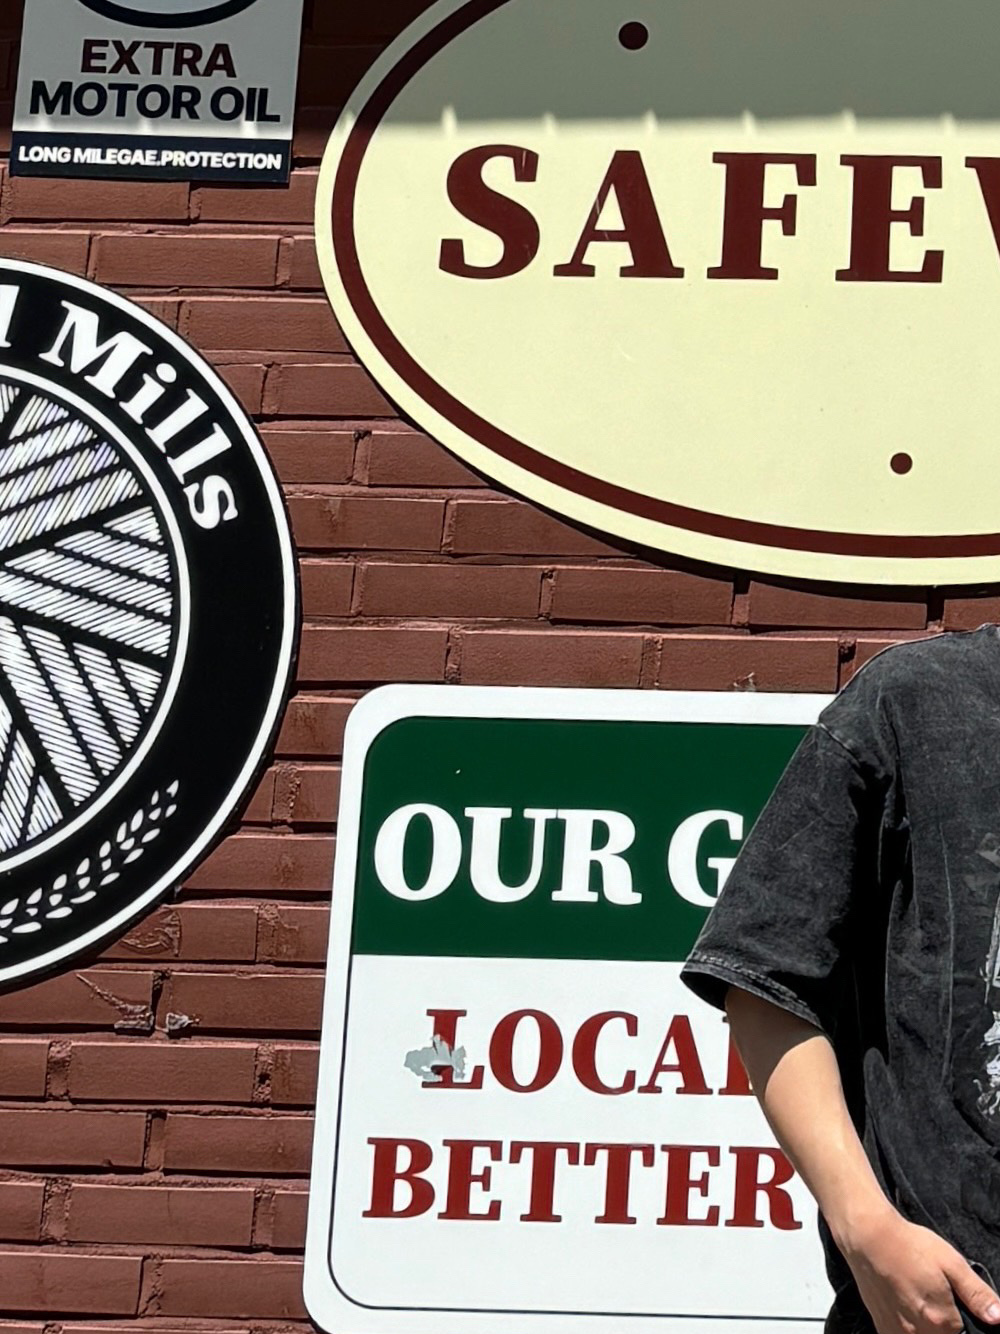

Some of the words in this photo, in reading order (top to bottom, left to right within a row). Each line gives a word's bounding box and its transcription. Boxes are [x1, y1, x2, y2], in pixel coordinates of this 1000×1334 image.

[80, 38, 238, 79] EXTRA
[29, 80, 202, 120] MOTOR
[209, 85, 281, 123] OIL
[18, 145, 71, 164] LONG
[46, 300, 239, 530] Mills
[373, 803, 643, 906] OUR
[361, 1137, 803, 1231] BETTER
